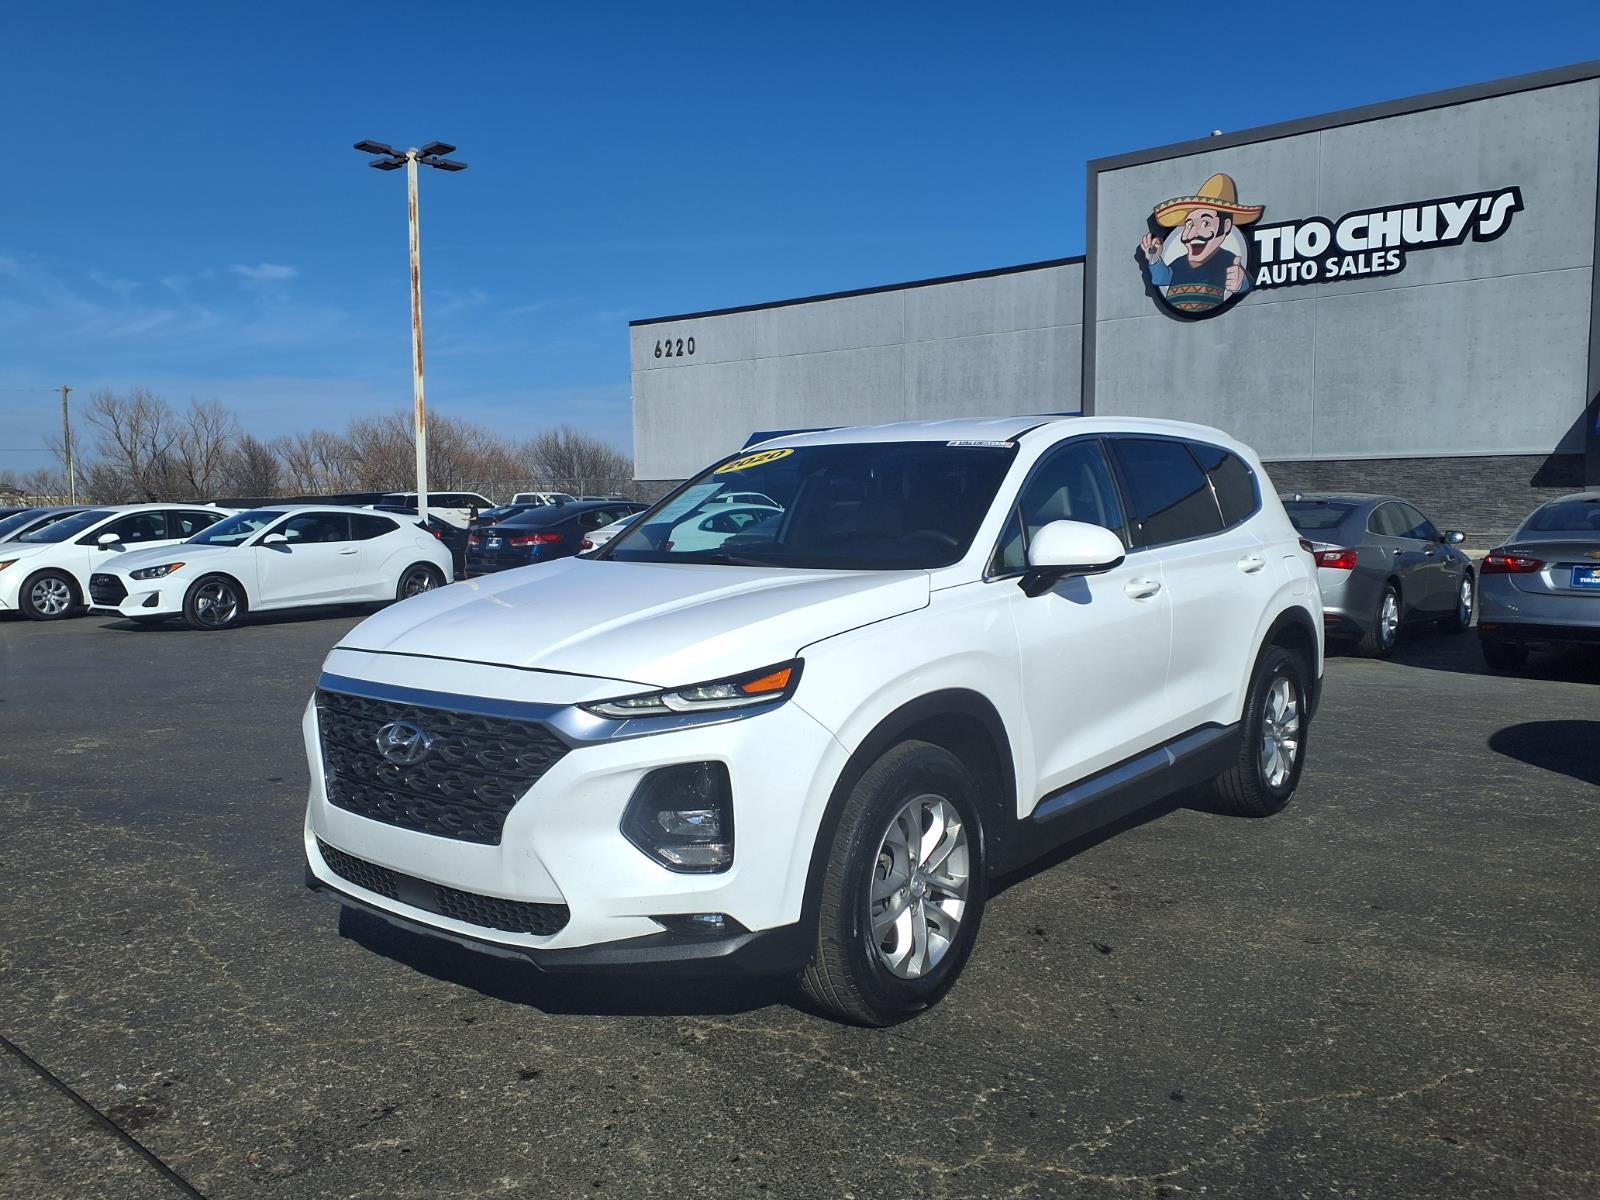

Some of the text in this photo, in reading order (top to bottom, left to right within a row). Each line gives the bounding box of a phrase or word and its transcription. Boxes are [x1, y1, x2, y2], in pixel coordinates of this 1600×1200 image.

[1254, 222, 1331, 263] TIO
[1255, 249, 1400, 286] AUTO SALES
[654, 336, 695, 358] 6220
[721, 450, 787, 472] 2020
